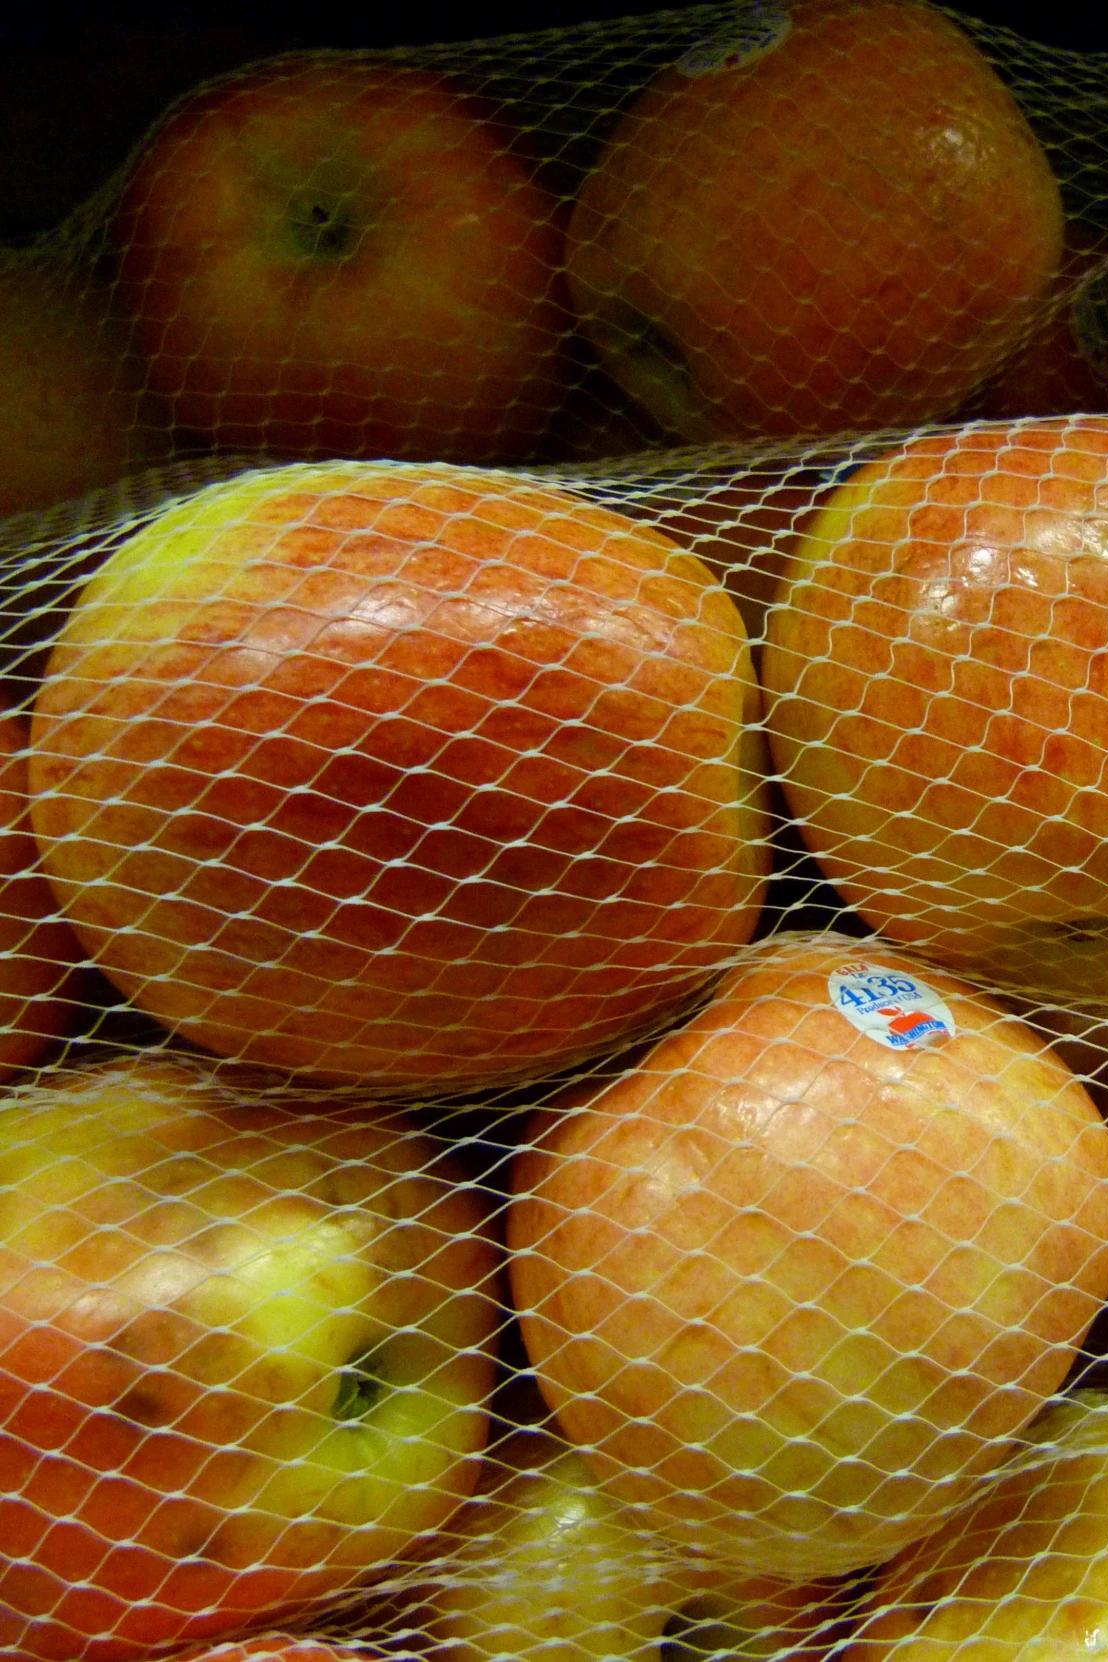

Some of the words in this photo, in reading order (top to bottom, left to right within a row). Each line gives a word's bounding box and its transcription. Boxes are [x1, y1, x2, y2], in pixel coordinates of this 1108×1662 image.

[835, 963, 869, 976] GALA
[839, 975, 917, 1008] 4135
[856, 999, 894, 1015] Produce
